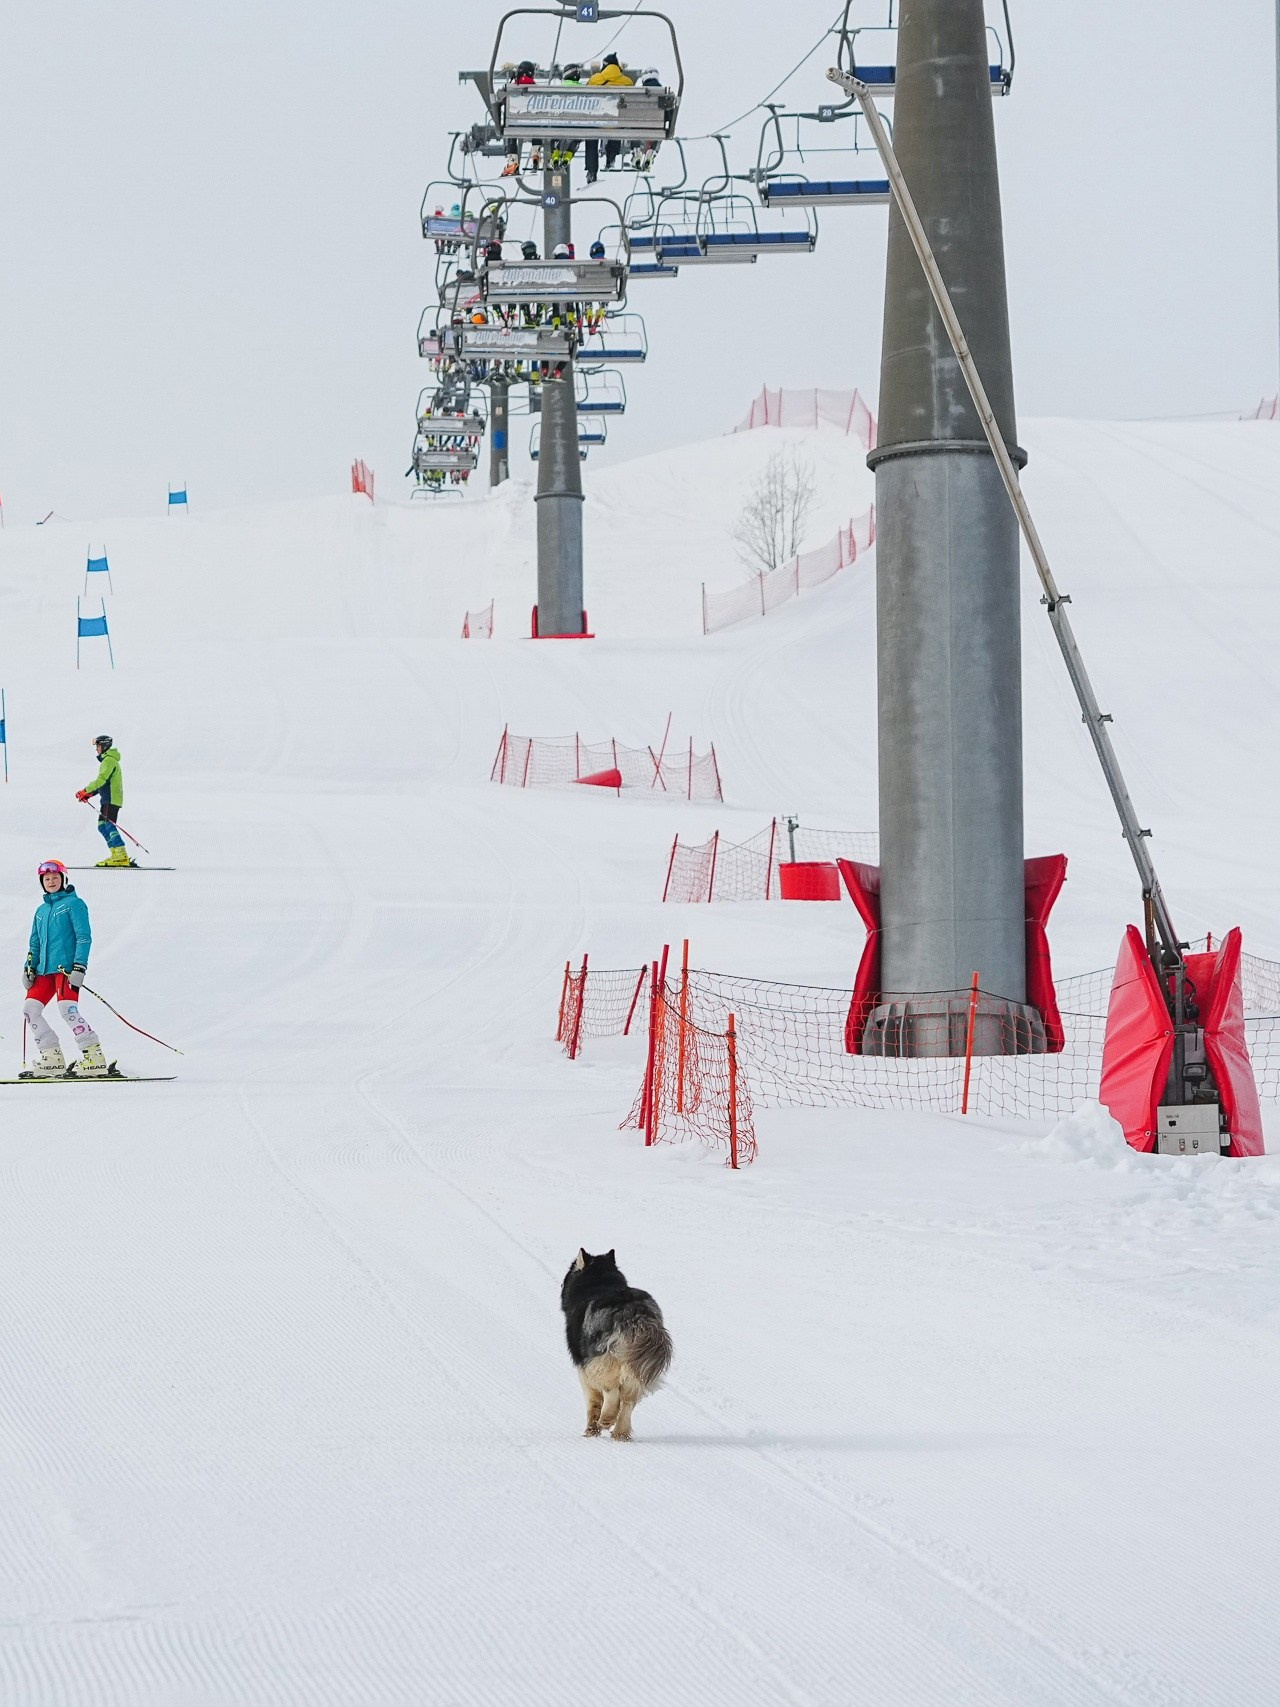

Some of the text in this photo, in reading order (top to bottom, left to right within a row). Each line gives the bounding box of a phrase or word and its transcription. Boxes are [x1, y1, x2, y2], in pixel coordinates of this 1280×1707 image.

[582, 7, 593, 16] 41
[527, 95, 600, 112] Adrenaline
[545, 196, 556, 205] 40
